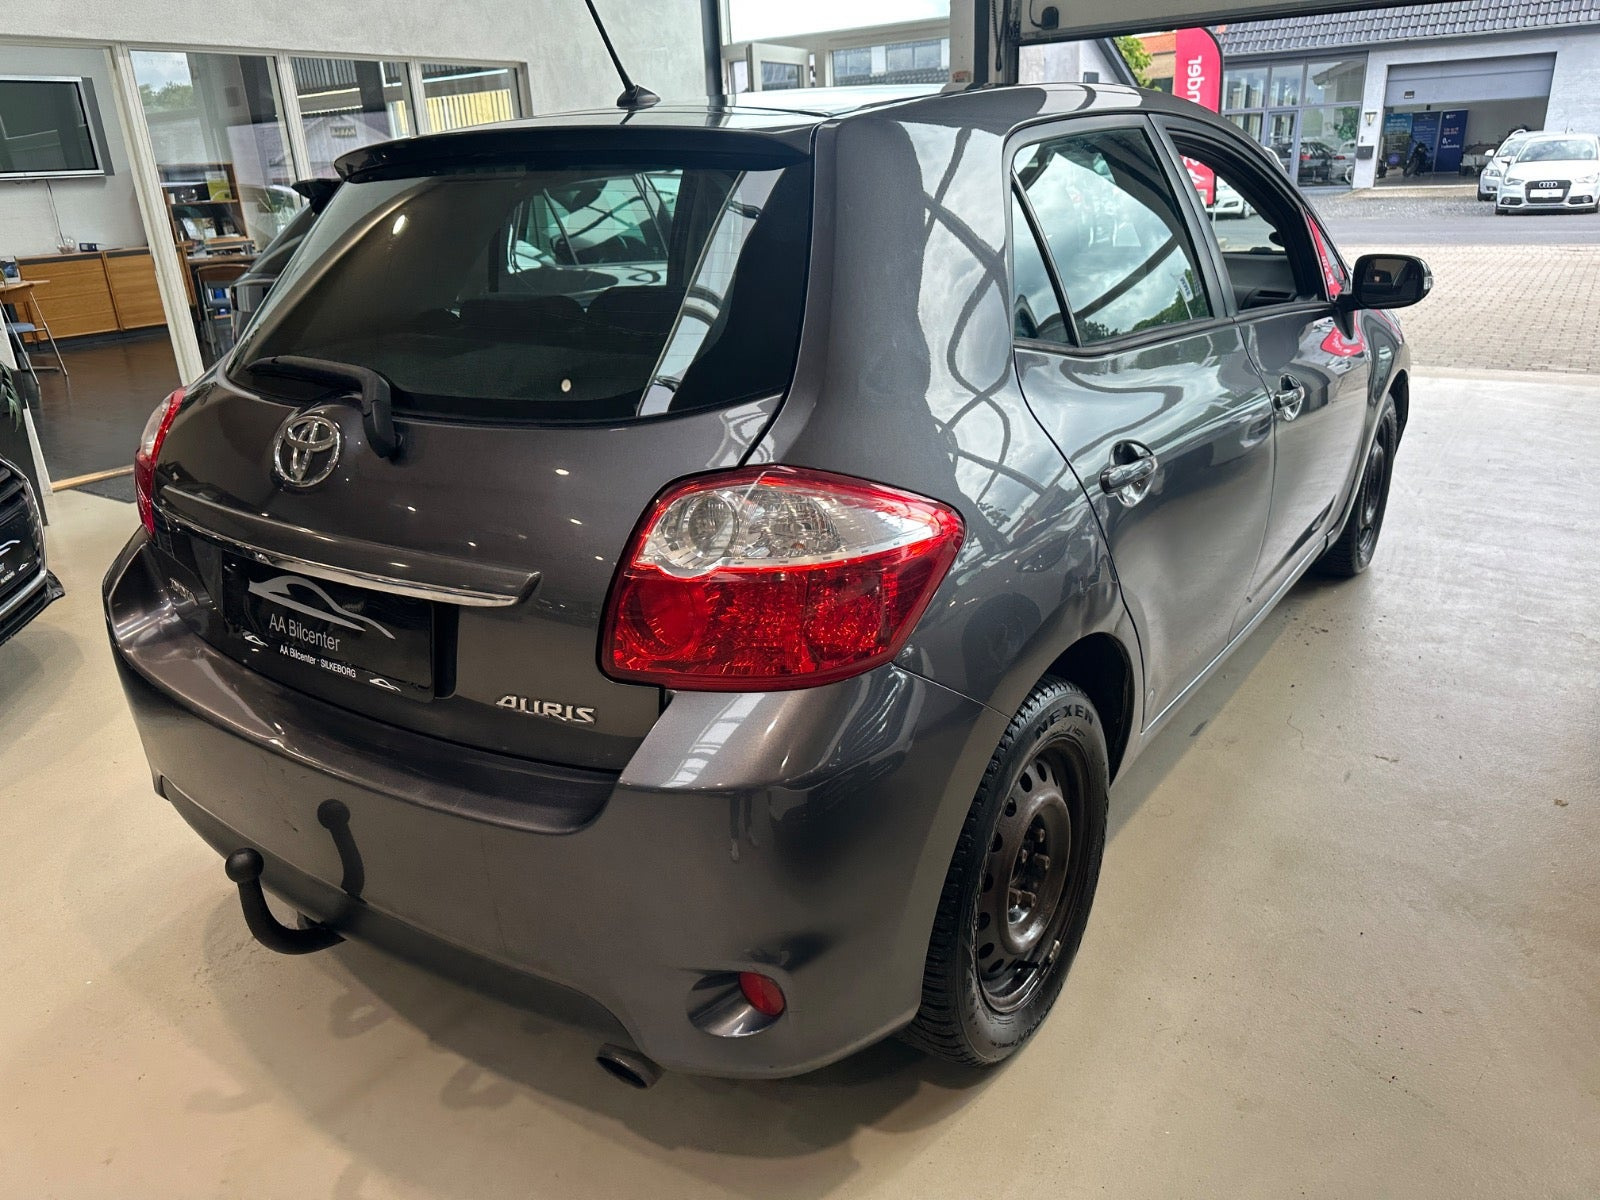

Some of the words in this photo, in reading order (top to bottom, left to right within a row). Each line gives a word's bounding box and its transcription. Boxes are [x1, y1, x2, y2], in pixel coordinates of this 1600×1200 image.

[269, 613, 287, 634] AA
[288, 618, 341, 651] Bilcenter
[279, 644, 289, 656] AA
[289, 647, 317, 665] Bilcenter
[320, 658, 356, 678] SILKEBORG
[496, 695, 595, 724] AURIS
[1034, 704, 1095, 740] NEXEN
